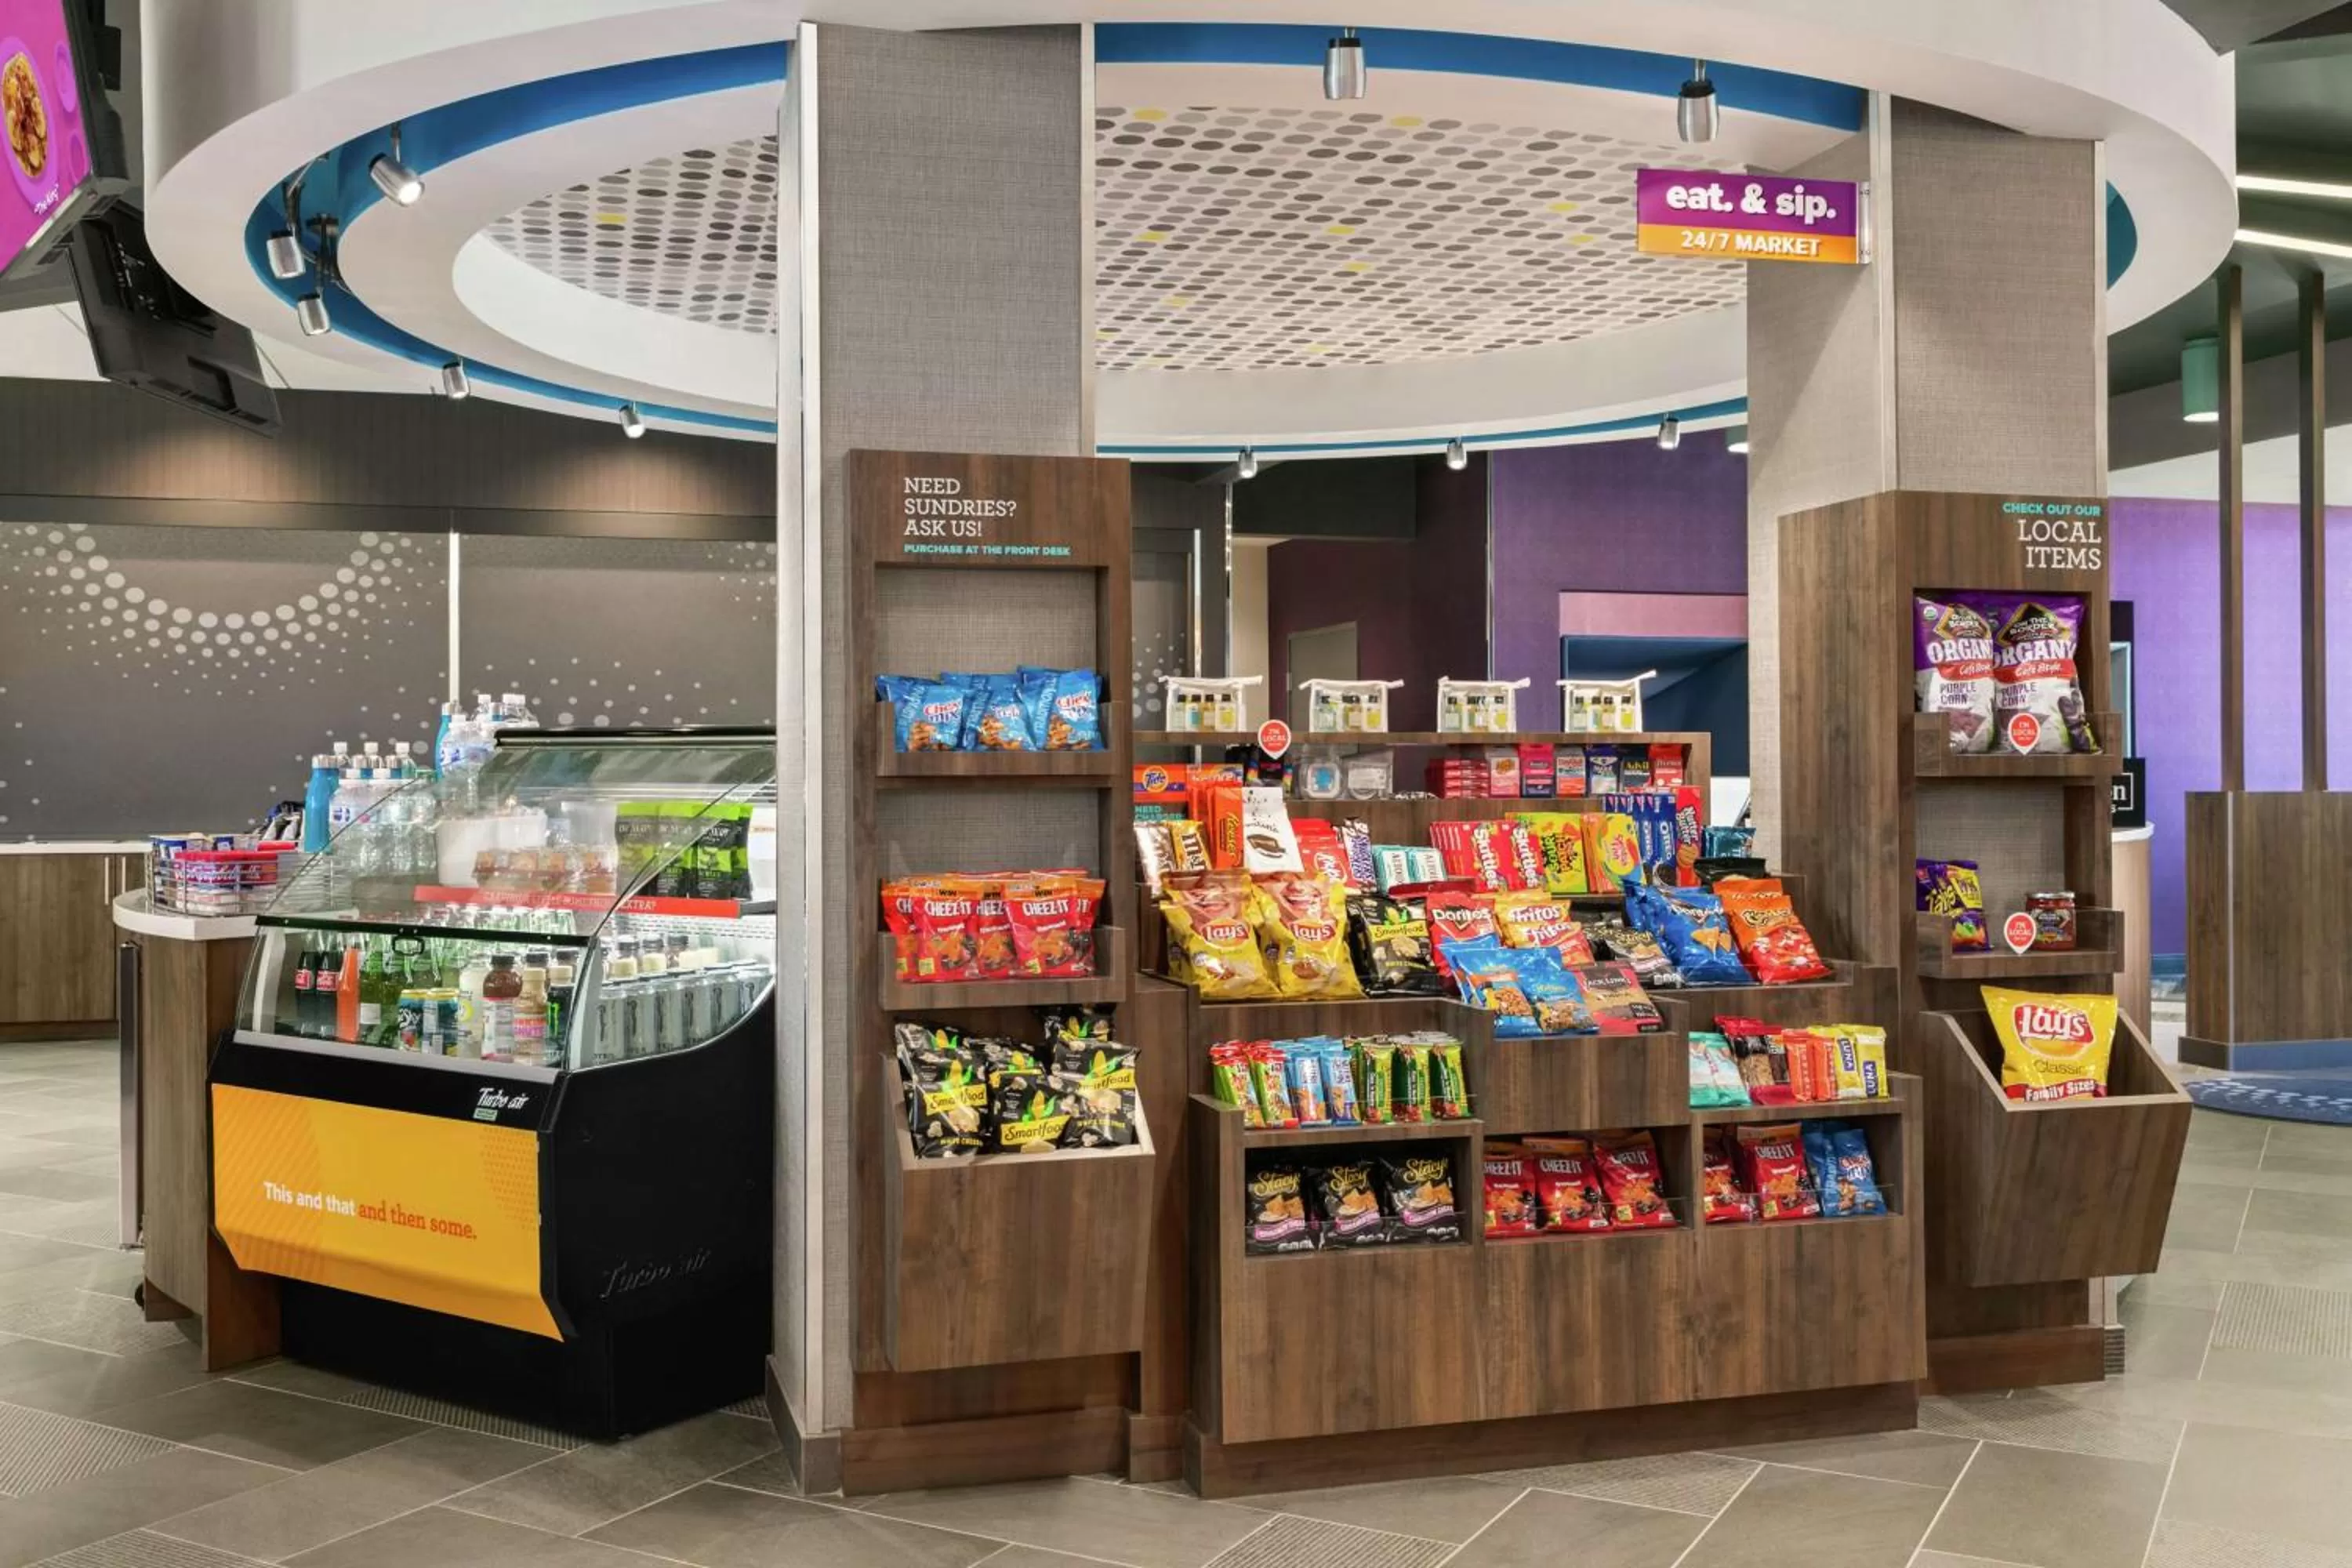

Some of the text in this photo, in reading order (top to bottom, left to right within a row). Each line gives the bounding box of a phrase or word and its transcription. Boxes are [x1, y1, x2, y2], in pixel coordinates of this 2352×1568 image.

[1666, 183, 1837, 225] eat. & sip.
[1682, 230, 1821, 256] 24/7 MARKET
[904, 477, 960, 495] NEED
[904, 499, 1017, 517] SUNDRIES?
[2002, 503, 2100, 516] CHECK OUT OUR
[904, 520, 982, 537] ASK US!
[2018, 519, 2101, 543] LOCAL
[904, 545, 1071, 557] PURCHASE AT THE FRONT DESK
[2026, 546, 2101, 570] ITEMS
[1940, 681, 1976, 693] PURPLE
[924, 700, 961, 715] Chex
[1940, 694, 1968, 704] CORN
[2002, 695, 2026, 706] CORN
[1625, 760, 1650, 770] Advil
[1145, 772, 1167, 790] Tide
[1474, 827, 1499, 889] Skittles
[1512, 826, 1537, 888] Skittles
[1433, 908, 1490, 921] Doritos
[1508, 906, 1560, 923] Fritos
[1840, 1040, 1854, 1069] LUNA
[1865, 1063, 1876, 1095] LUNA
[477, 1087, 529, 1109] Turbo air
[2025, 1085, 2064, 1102] Family
[1484, 1160, 1523, 1176] HEEZ-IT
[1540, 1158, 1582, 1174] CHEEZ-IT
[263, 1181, 477, 1240] This and that and then some.
